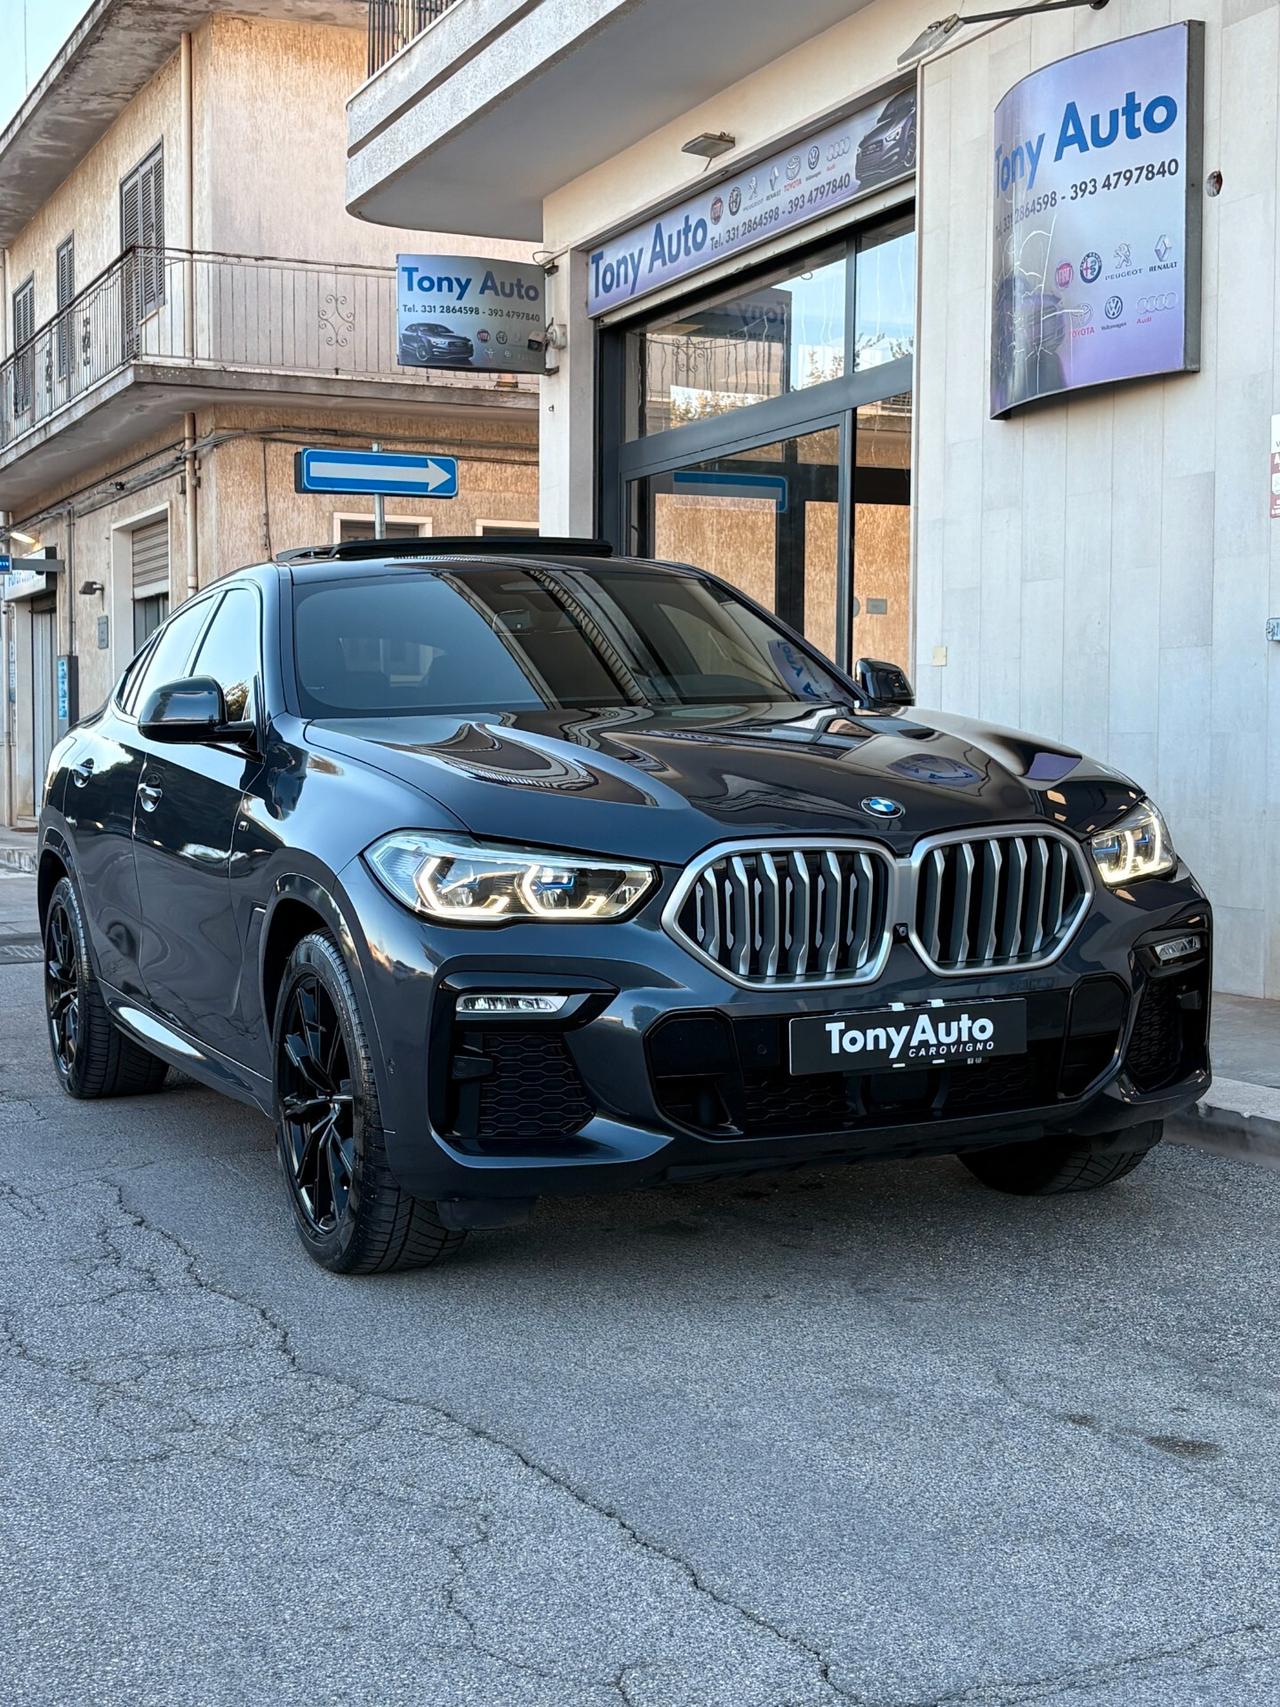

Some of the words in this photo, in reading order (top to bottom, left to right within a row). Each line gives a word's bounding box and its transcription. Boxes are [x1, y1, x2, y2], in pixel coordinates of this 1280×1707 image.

[995, 133, 1045, 198] Tony
[1053, 91, 1178, 162] Auto
[710, 233, 724, 251] Tel.
[725, 226, 739, 244] 331
[741, 206, 780, 237] 2864598
[788, 193, 805, 215] 393
[807, 172, 851, 206] 4797840
[1014, 190, 1058, 225] 2864598
[1070, 178, 1098, 201] 393
[1101, 158, 1179, 192] 4797840
[591, 246, 644, 298] Tony
[648, 214, 707, 274] Auto
[1105, 268, 1144, 280] PEUGEOT
[1149, 261, 1177, 273] RENAULT
[402, 267, 472, 300] Tony
[479, 270, 539, 301] Auto
[403, 304, 418, 313] Tel.
[421, 305, 436, 314] 331
[440, 305, 480, 315] 2864598
[488, 309, 504, 318] 393
[506, 310, 540, 322] 4797840
[825, 1013, 994, 1059] TonyAuto
[908, 1041, 995, 1058] CAROVIGNO
